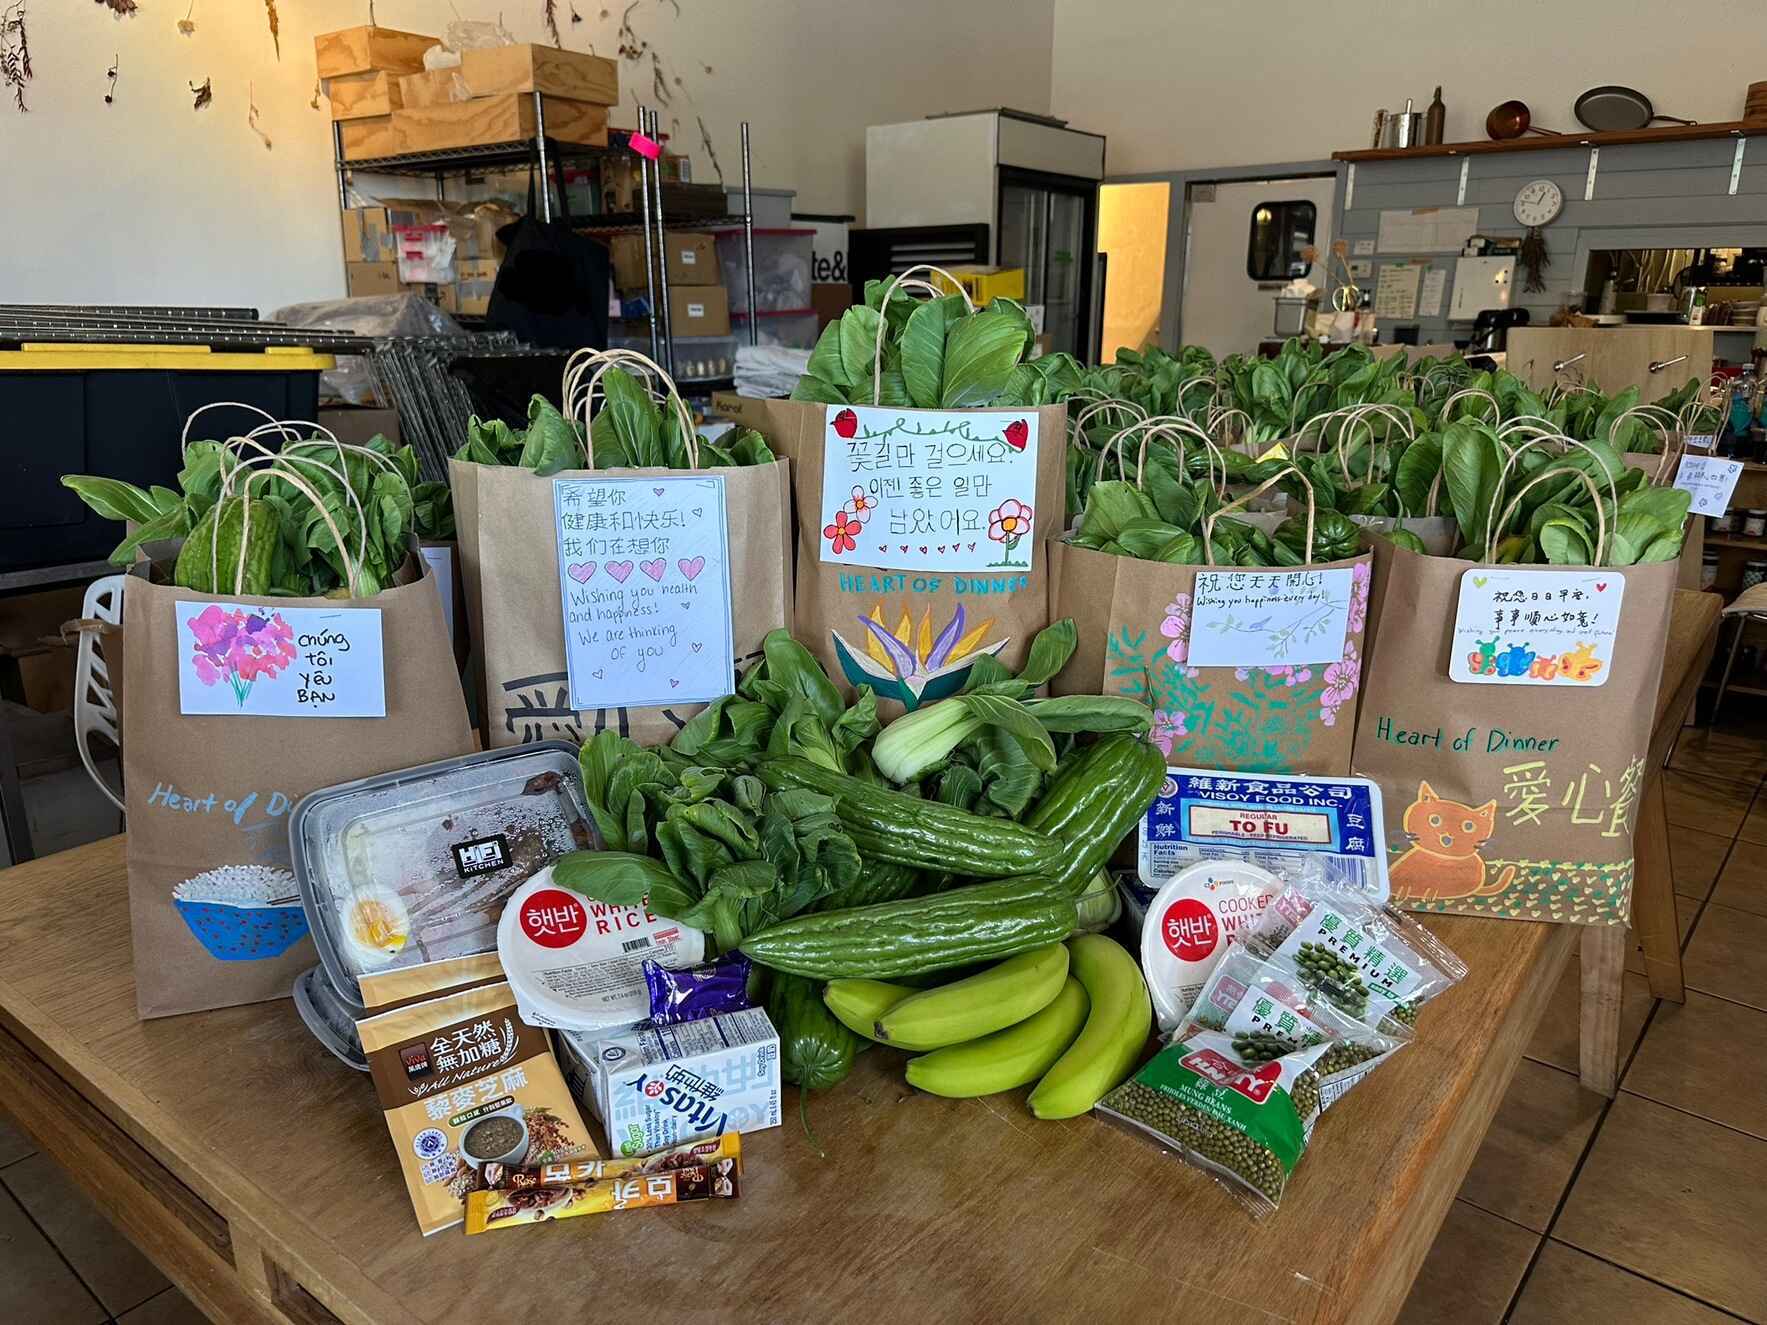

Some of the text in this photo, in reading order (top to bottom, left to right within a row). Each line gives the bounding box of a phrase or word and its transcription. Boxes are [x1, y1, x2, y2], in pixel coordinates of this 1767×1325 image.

[847, 442, 916, 472] 꽃길만
[563, 488, 626, 507] 希望你
[869, 474, 992, 498] 이젠 좋은 일만
[561, 508, 687, 531] 健康和快乐!
[563, 537, 670, 556] 我们在想你
[570, 582, 698, 609] Wishing you health
[838, 573, 907, 594] HEART
[911, 576, 941, 593] OF
[1228, 597, 1242, 608] you
[569, 608, 592, 623] and
[579, 624, 677, 647] We are thinking
[305, 650, 333, 667] tôi
[637, 646, 664, 672] you
[1376, 716, 1560, 753] Heart of Dinner
[1188, 776, 1353, 800] 維新食品公司
[1200, 790, 1343, 808] VISOY FOOD INC.
[147, 782, 218, 814] Heart
[223, 791, 258, 825] of
[1229, 819, 1289, 835] TO FU
[1240, 811, 1278, 821] REGULAR
[1153, 843, 1188, 851] Nutrition
[464, 860, 505, 873] KITCHEN
[590, 896, 650, 918] WHE
[526, 903, 580, 937] 햇반
[597, 911, 657, 935] RICE
[1168, 914, 1212, 948] 햇반
[1317, 928, 1394, 988] PREMIUM
[430, 1019, 497, 1058] 全天然
[1251, 1014, 1307, 1048] PREM
[435, 1038, 502, 1074] 無加糖
[664, 1064, 725, 1102] 維他奶
[1180, 1083, 1207, 1102] MUNG
[1203, 1094, 1232, 1114] BEANS
[630, 1122, 646, 1151] Sugar
[543, 1160, 606, 1183] 모카
[612, 1173, 674, 1202] 모카
